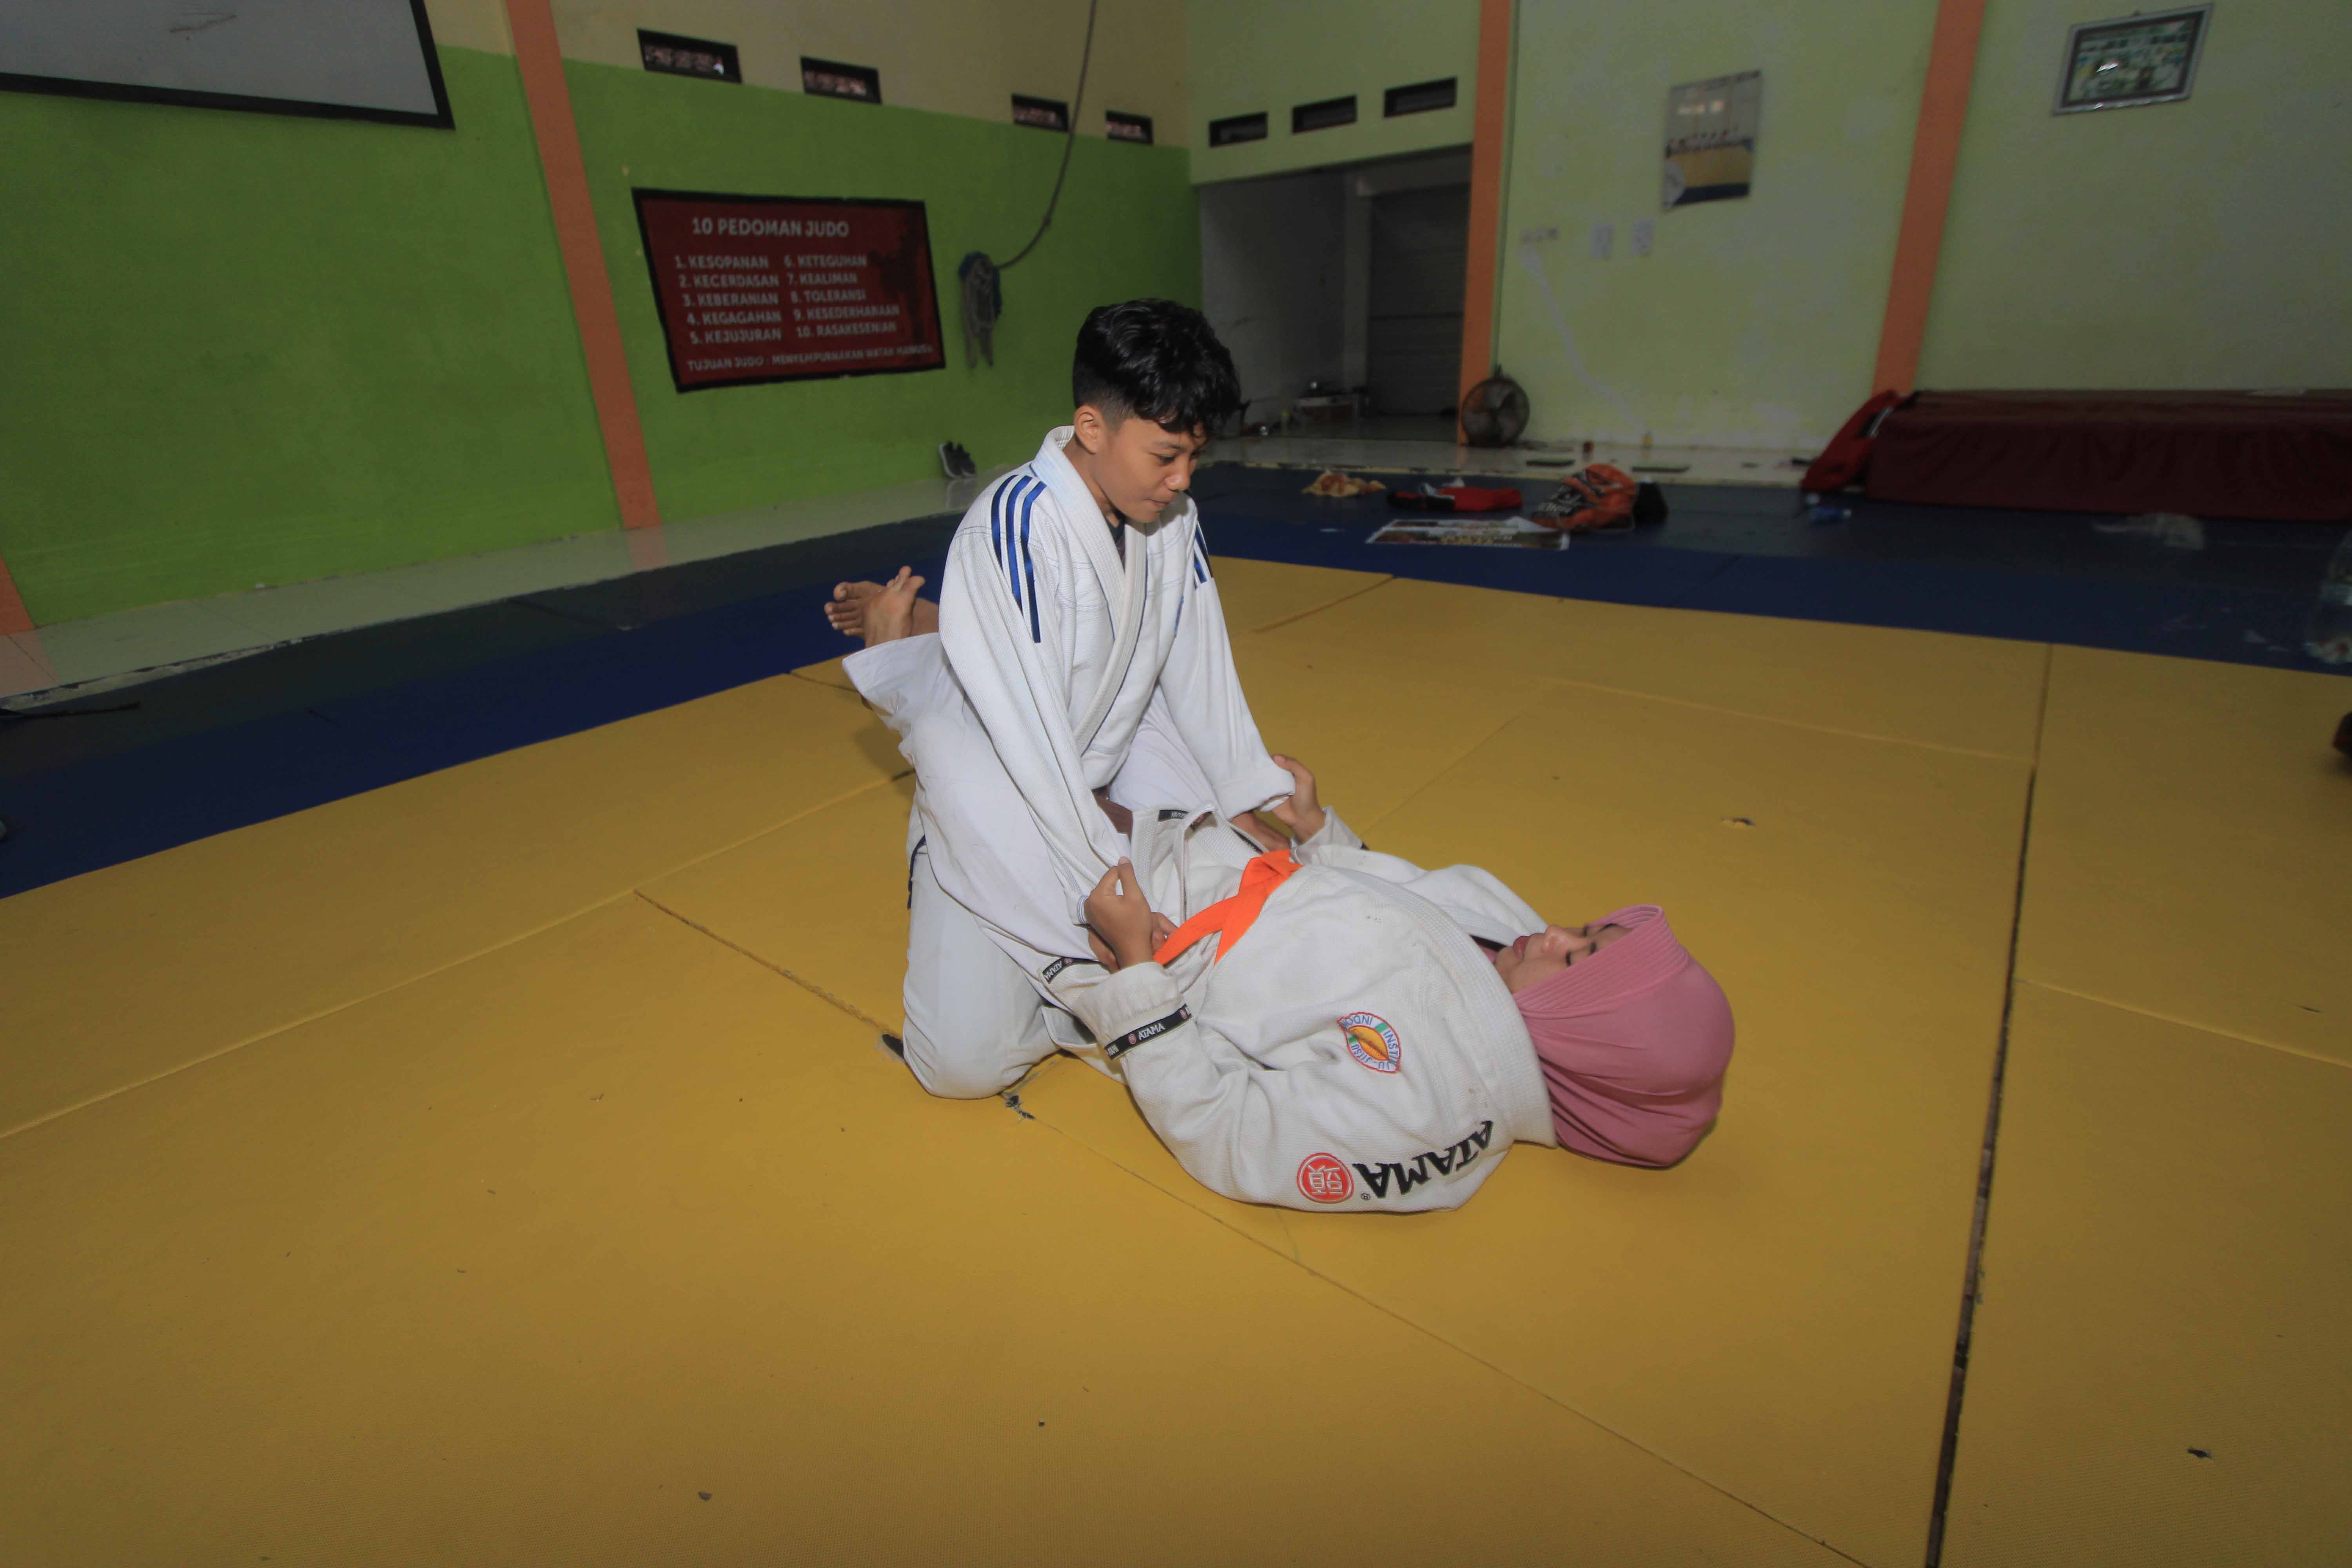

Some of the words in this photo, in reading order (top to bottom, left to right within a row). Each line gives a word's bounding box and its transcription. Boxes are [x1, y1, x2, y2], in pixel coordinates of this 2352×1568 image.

[691, 217, 713, 235] 10
[718, 218, 802, 236] PEDOMAN
[805, 220, 850, 237] JUDO
[674, 256, 686, 269] 1.
[688, 256, 769, 269] KESOPANAN
[797, 255, 867, 267] KETEGUHAN
[678, 274, 691, 288] 2.
[693, 274, 779, 288] KECERDASAN
[787, 273, 797, 285] 7.
[799, 273, 858, 285] KEALIMAN
[682, 293, 695, 307] 3.
[697, 293, 779, 307] KEBERANIAN
[802, 289, 867, 303] TOLERANSI
[686, 312, 700, 327] 4.
[702, 310, 782, 326] KEGAGAHAN
[806, 305, 900, 320] KESEDERHANAAN
[689, 331, 702, 345] 5.
[705, 327, 782, 345] KEJUJURAN
[796, 326, 813, 338] 10.
[686, 358, 733, 371] TUJUAN
[1044, 960, 1062, 980] ATAMA
[1138, 1023, 1166, 1040] ATAMA
